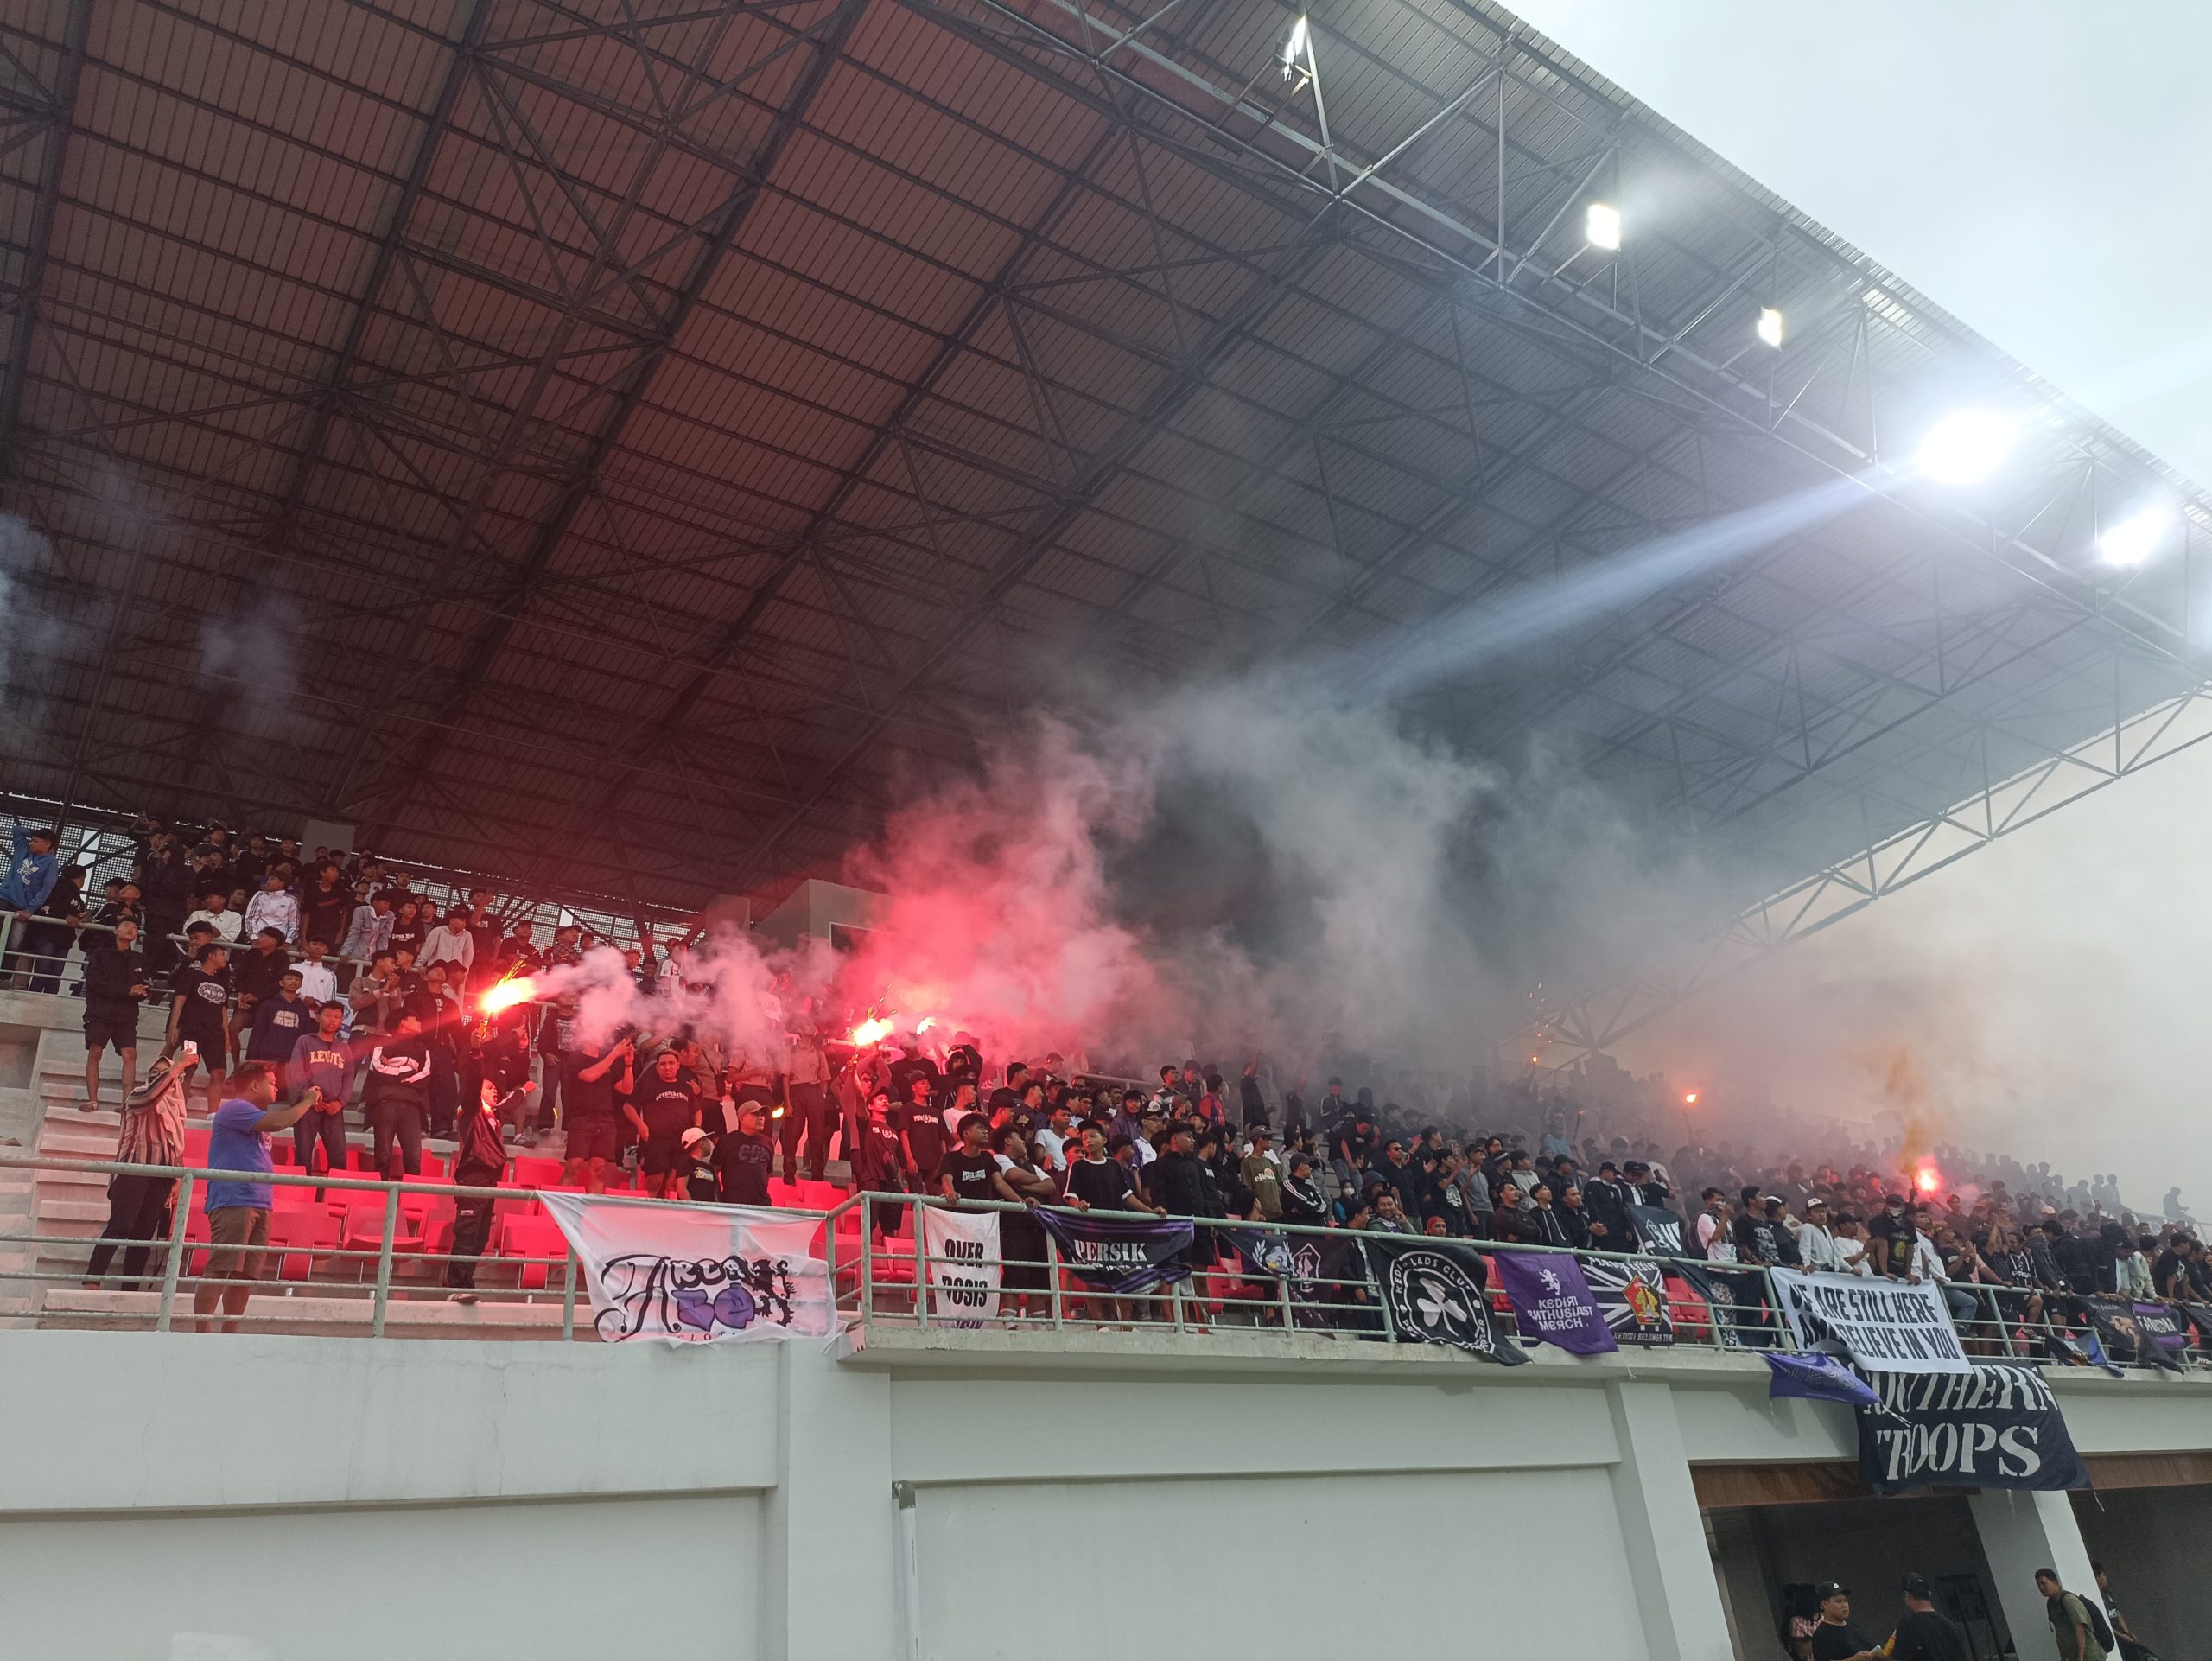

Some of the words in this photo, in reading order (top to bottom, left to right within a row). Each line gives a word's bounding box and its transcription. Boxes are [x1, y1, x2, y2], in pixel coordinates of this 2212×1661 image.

[944, 1238, 984, 1269] OVER
[1072, 1239, 1147, 1263] PERSIK
[1410, 1257, 1438, 1268] LADS
[1443, 1265, 1471, 1290] CLU
[1815, 1286, 1851, 1321] ARE
[1848, 1289, 1895, 1323] STILL
[1891, 1292, 1938, 1324] HERE
[1835, 1323, 1904, 1359] BELIEVE
[1899, 1328, 1929, 1359] IN
[1918, 1327, 1961, 1359] YOU
